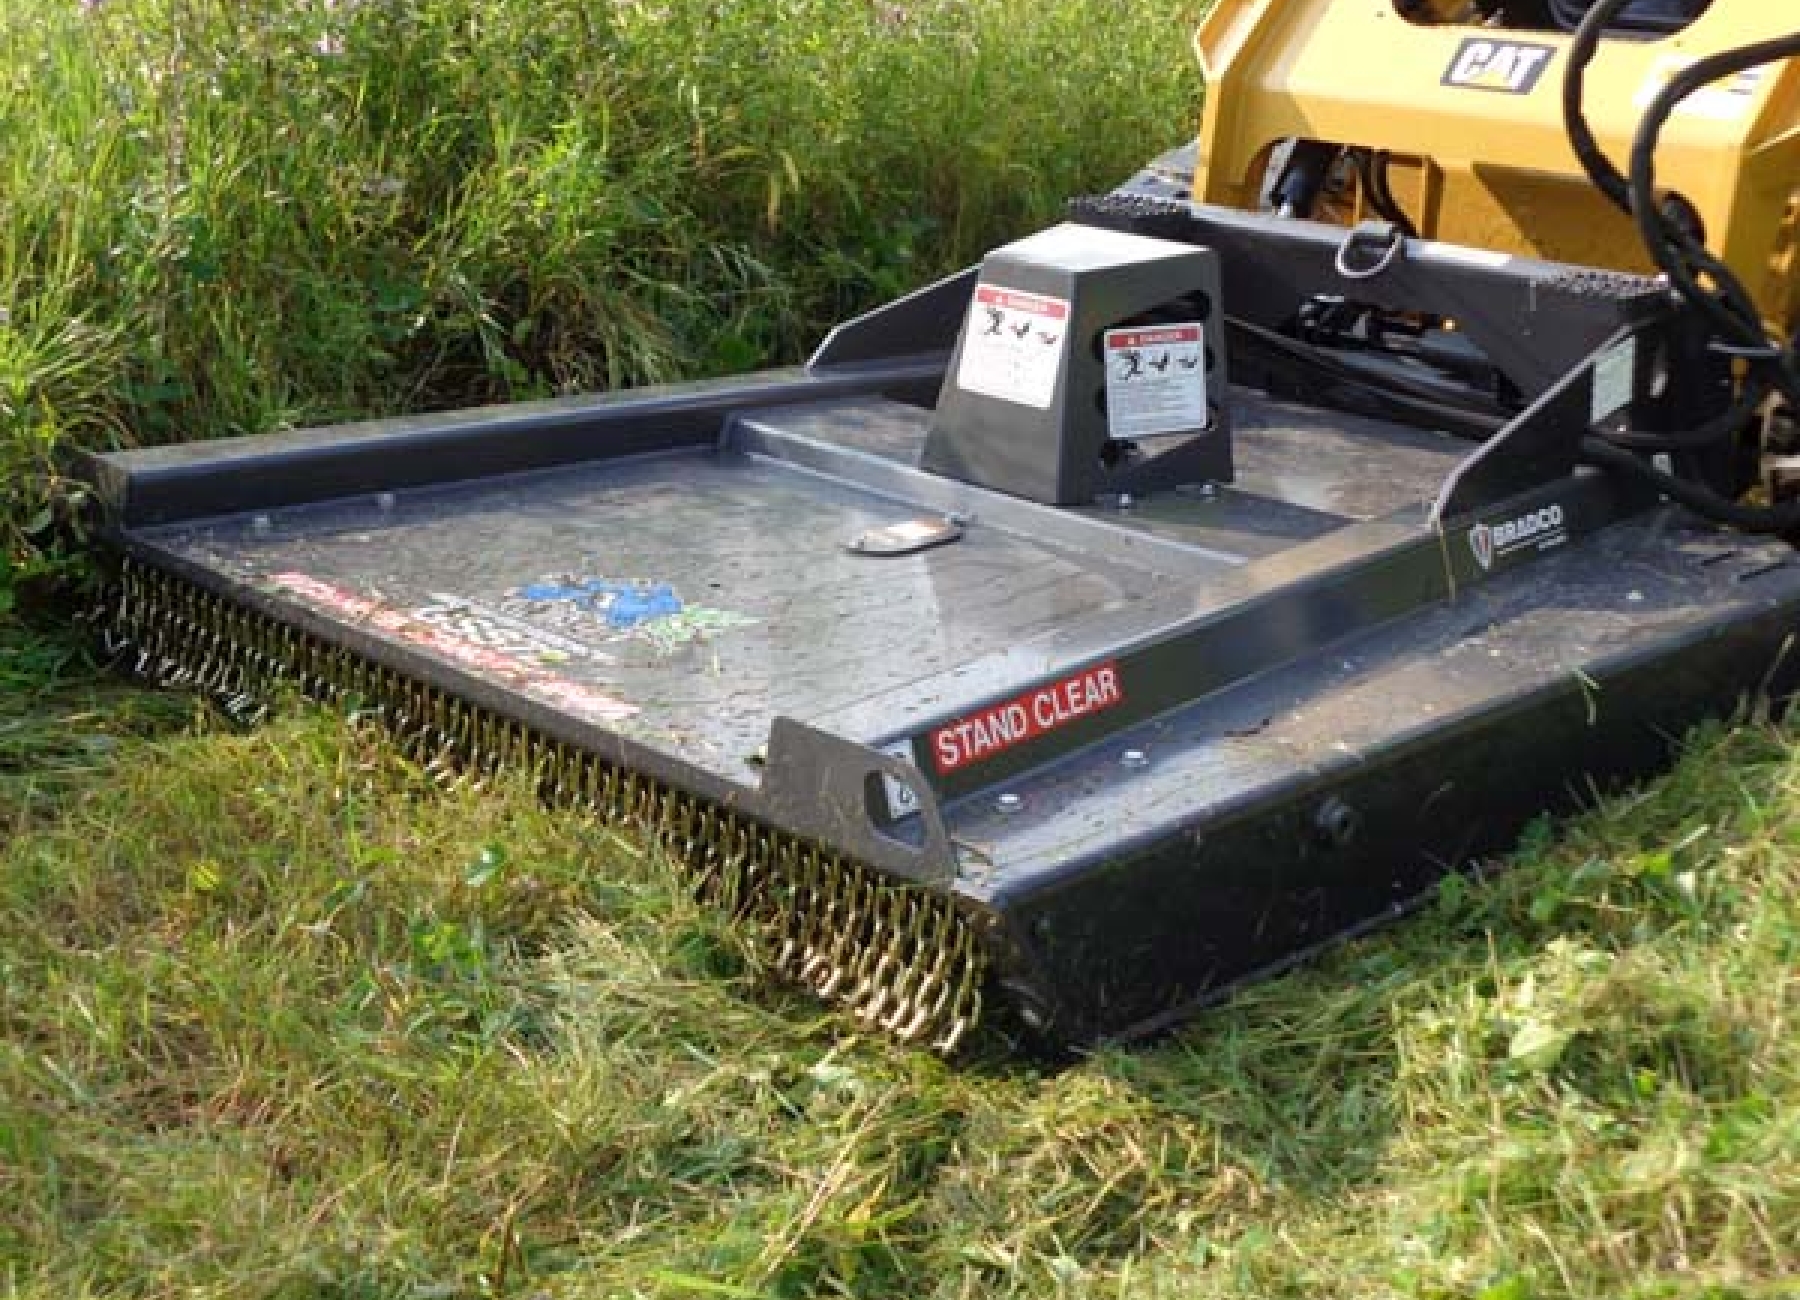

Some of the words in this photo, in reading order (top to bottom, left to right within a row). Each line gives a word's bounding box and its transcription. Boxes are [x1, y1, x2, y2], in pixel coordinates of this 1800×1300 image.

[1450, 41, 1549, 90] CAT
[938, 703, 1028, 766] STAND
[1034, 667, 1120, 729] CLEAR
